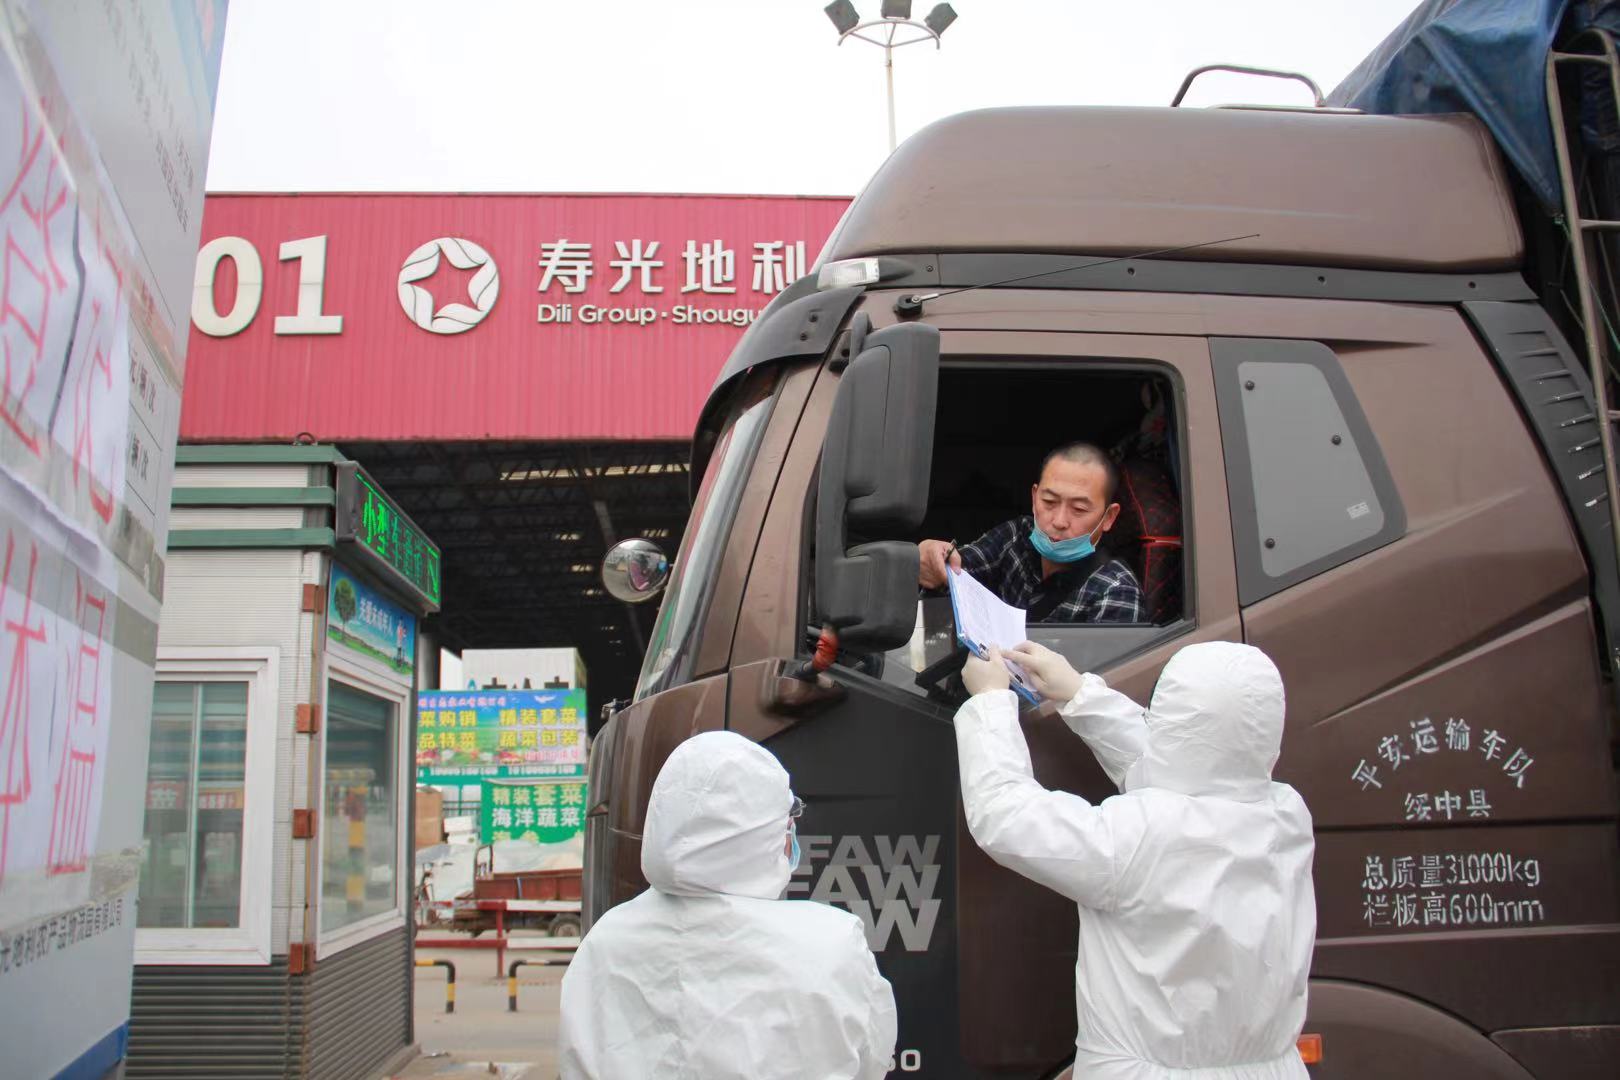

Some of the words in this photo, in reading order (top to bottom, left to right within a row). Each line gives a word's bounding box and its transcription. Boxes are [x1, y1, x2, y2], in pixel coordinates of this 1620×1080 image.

[537, 239, 806, 295] 寿光地利
[190, 234, 344, 338] 01
[536, 304, 572, 324] Dili
[1351, 716, 1535, 790] 平安运输车队
[492, 783, 583, 806] 精装套菜
[1404, 788, 1492, 821] 绥中县
[491, 806, 586, 828] 海洋蔬菜
